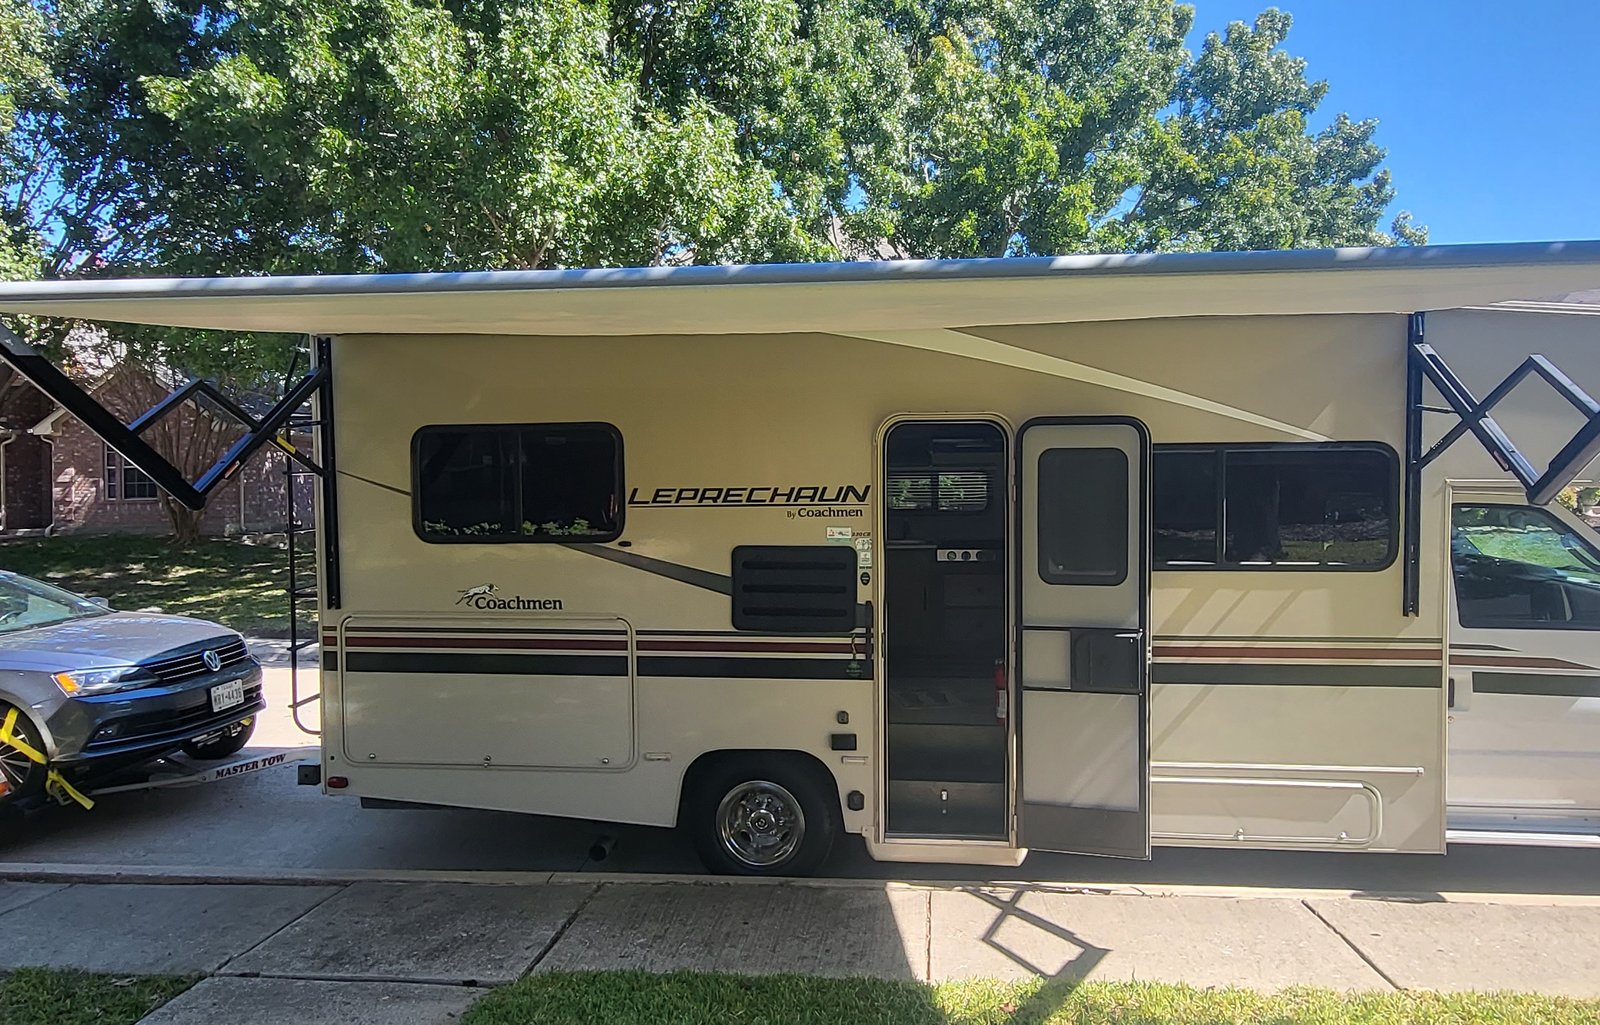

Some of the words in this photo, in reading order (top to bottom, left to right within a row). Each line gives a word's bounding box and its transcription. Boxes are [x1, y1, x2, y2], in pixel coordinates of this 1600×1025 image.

[628, 485, 871, 505] LEPRECHAUN
[786, 510, 796, 520] By
[798, 507, 863, 518] Coachmen
[474, 596, 563, 610] Coachmen
[215, 760, 259, 779] MASTER
[261, 753, 287, 768] TOW
